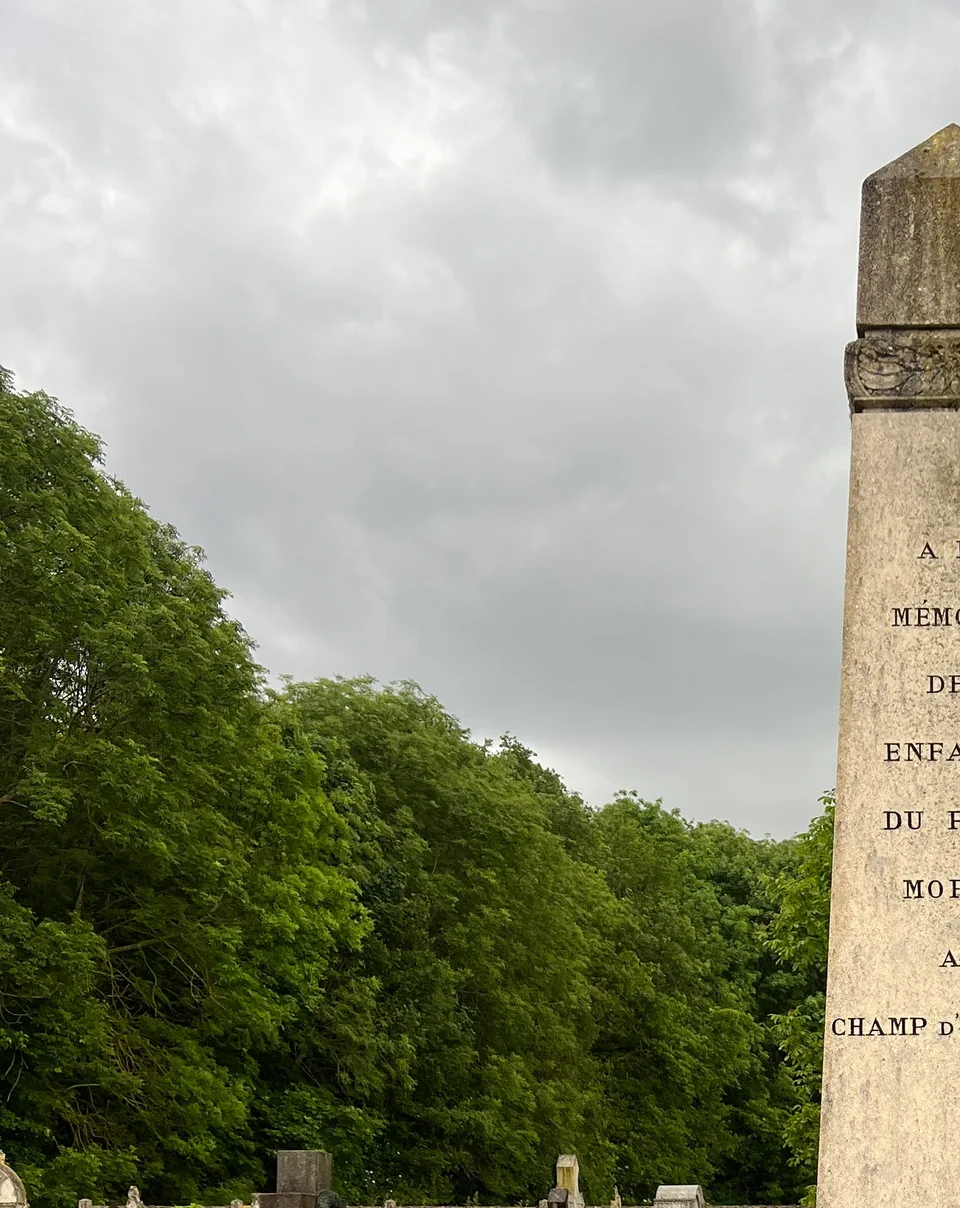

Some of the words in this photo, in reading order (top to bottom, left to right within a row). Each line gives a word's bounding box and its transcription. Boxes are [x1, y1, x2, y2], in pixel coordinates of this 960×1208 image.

[917, 542, 938, 559] A
[883, 810, 924, 830] DU
[831, 1017, 927, 1037] CHAMP
